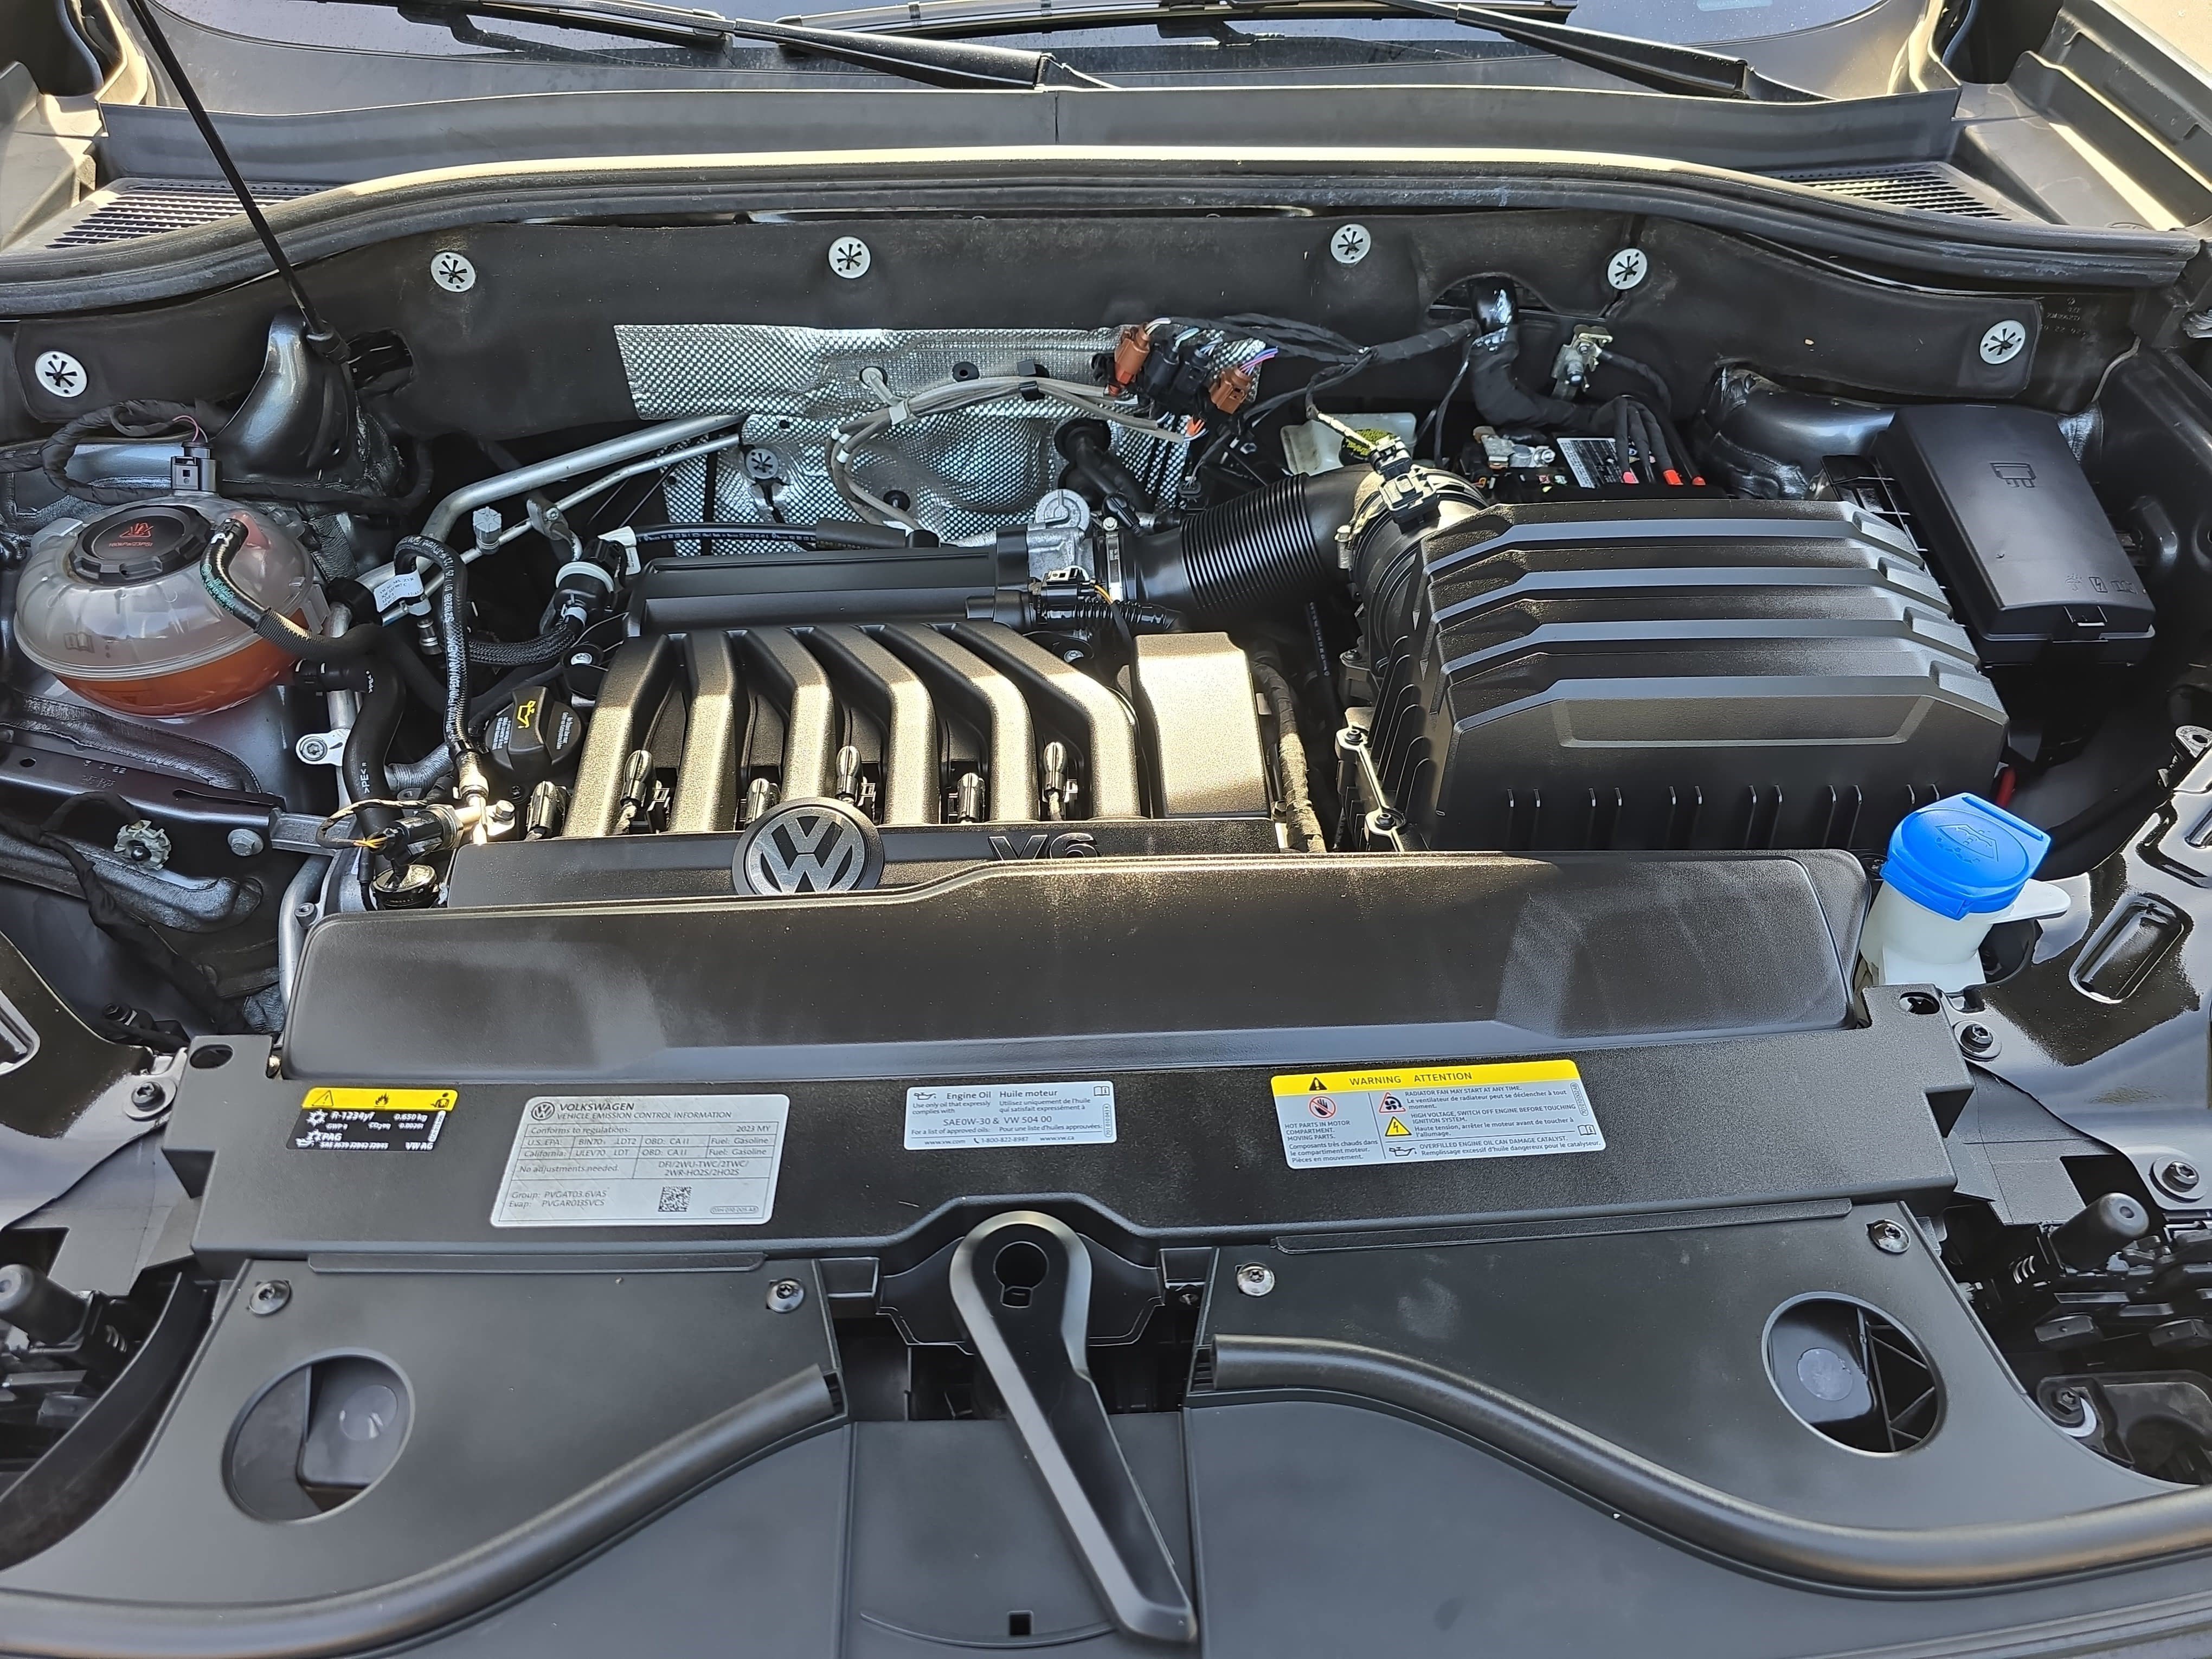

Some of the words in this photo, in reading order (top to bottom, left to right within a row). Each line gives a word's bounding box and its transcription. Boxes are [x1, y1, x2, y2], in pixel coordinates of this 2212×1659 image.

[1349, 1076, 1401, 1085] WARNING
[1414, 1072, 1472, 1083] ATTENTION
[946, 1092, 977, 1101] Engine
[560, 1103, 635, 1111] VOLKSWAGEN
[583, 1126, 632, 1136] regulations:
[946, 1127, 976, 1135] approved
[1285, 1127, 1335, 1135] COMPARTMENT.
[322, 1132, 343, 1141] PAG
[404, 1141, 421, 1150] VW
[420, 1142, 434, 1150] AG
[1289, 1142, 1327, 1150] Composants
[1510, 1144, 1543, 1152] dangereux
[1567, 1140, 1601, 1148] catalyseur.
[709, 1148, 729, 1156] Fuel:
[731, 1147, 767, 1155] Gasoline
[1297, 1148, 1343, 1157] compartiment
[533, 1165, 585, 1174] adjustments
[511, 1191, 541, 1200] Group:
